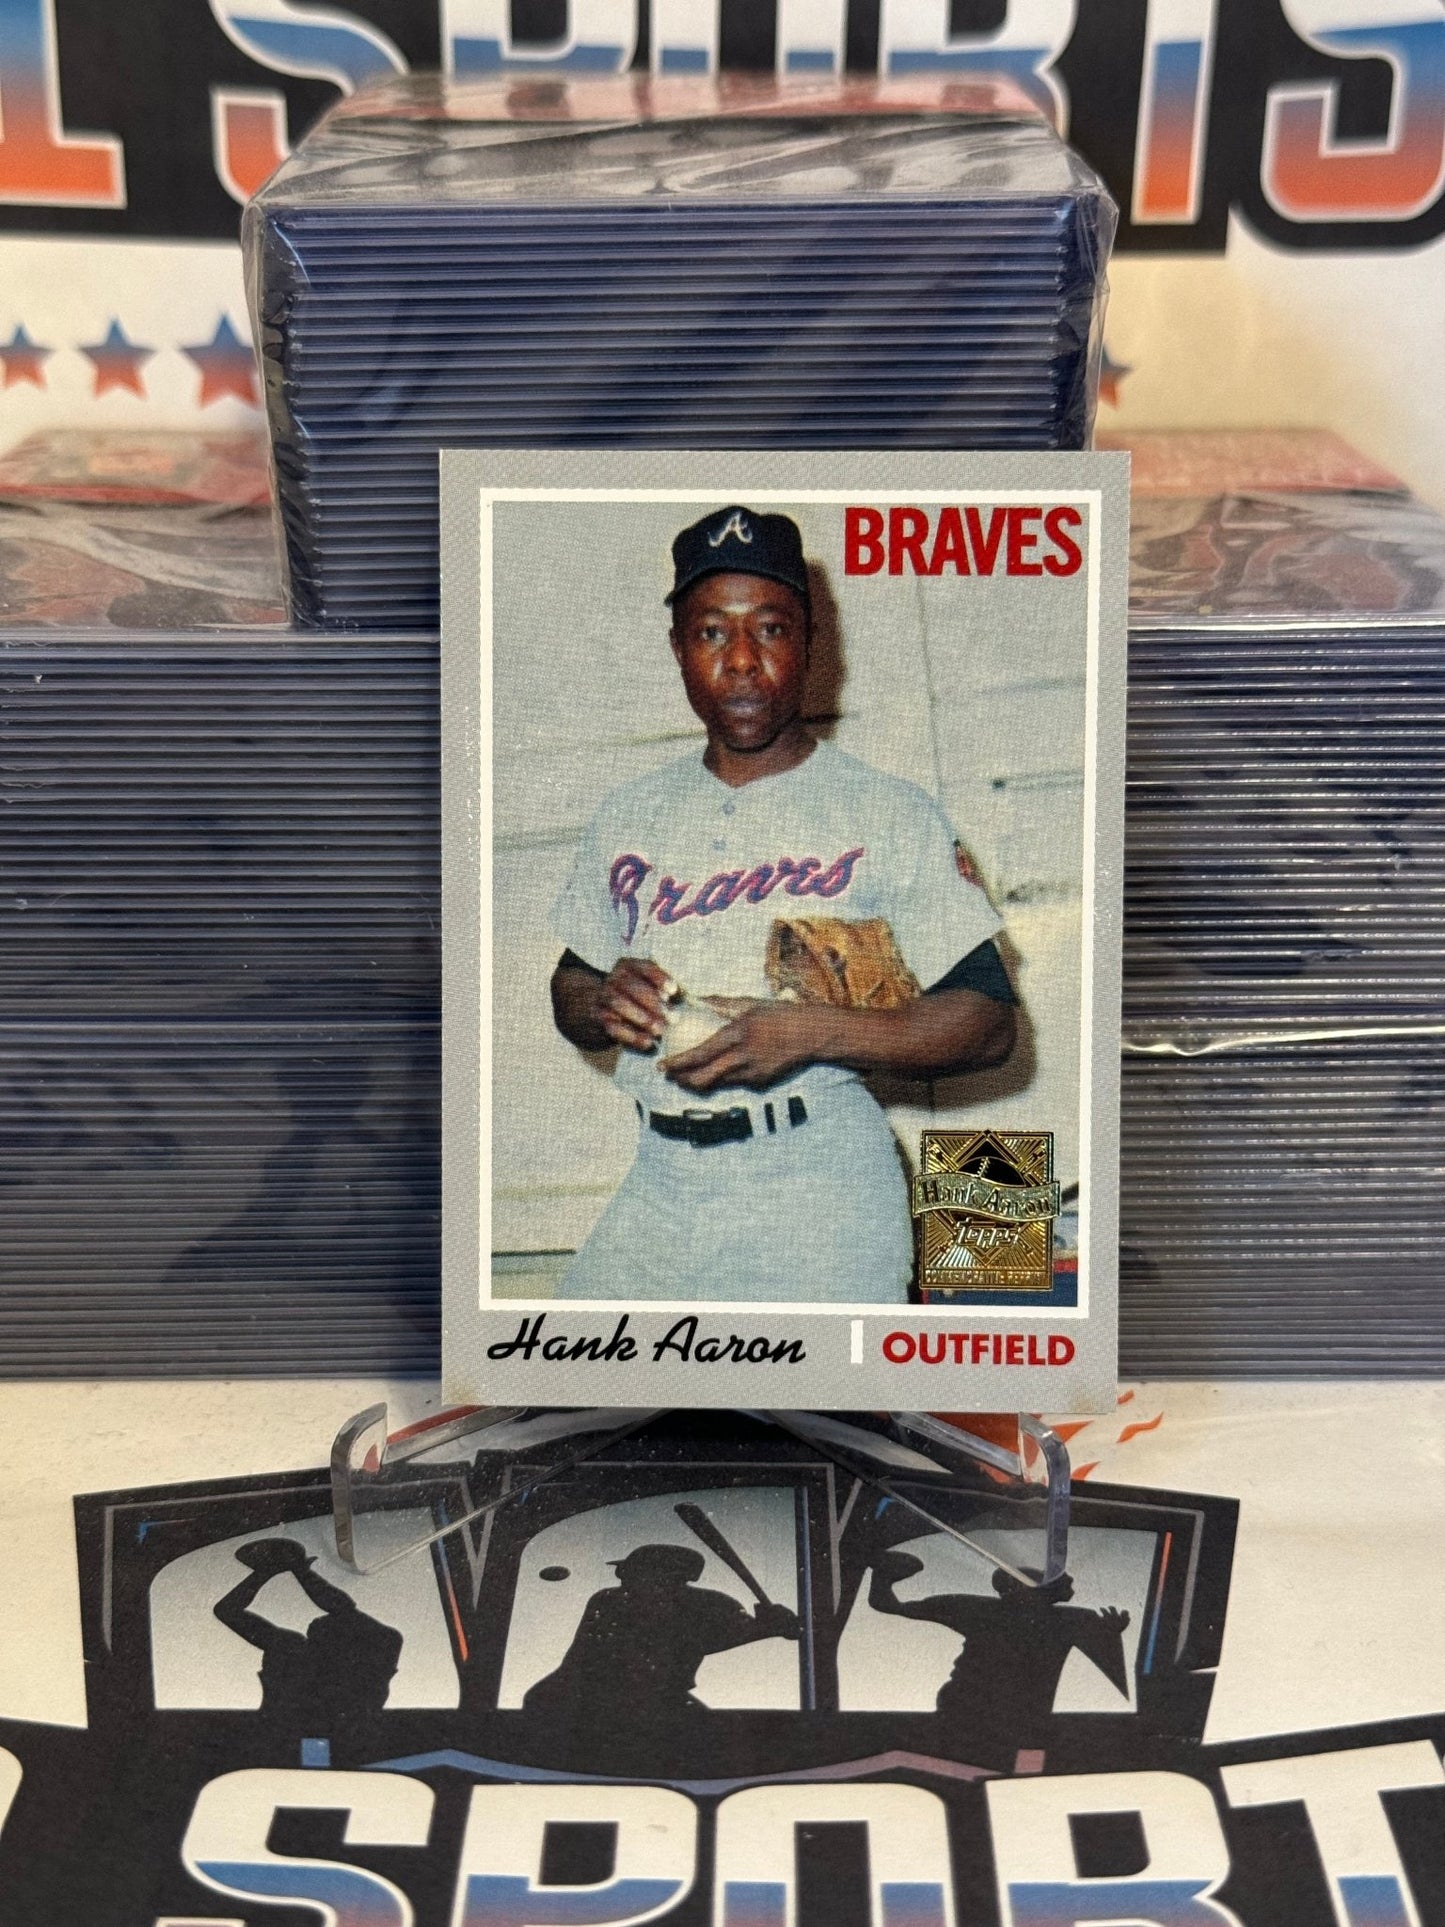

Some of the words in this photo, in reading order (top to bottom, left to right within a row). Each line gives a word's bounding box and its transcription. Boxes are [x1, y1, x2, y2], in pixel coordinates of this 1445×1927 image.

[844, 507, 1083, 577] BRAVES
[609, 847, 865, 945] Braves
[920, 1179, 981, 1205] Hank
[979, 1186, 1052, 1217] Aaron
[487, 1312, 638, 1361] Hank
[652, 1315, 806, 1363] Aaron
[882, 1331, 1076, 1366] OUTFIELD
